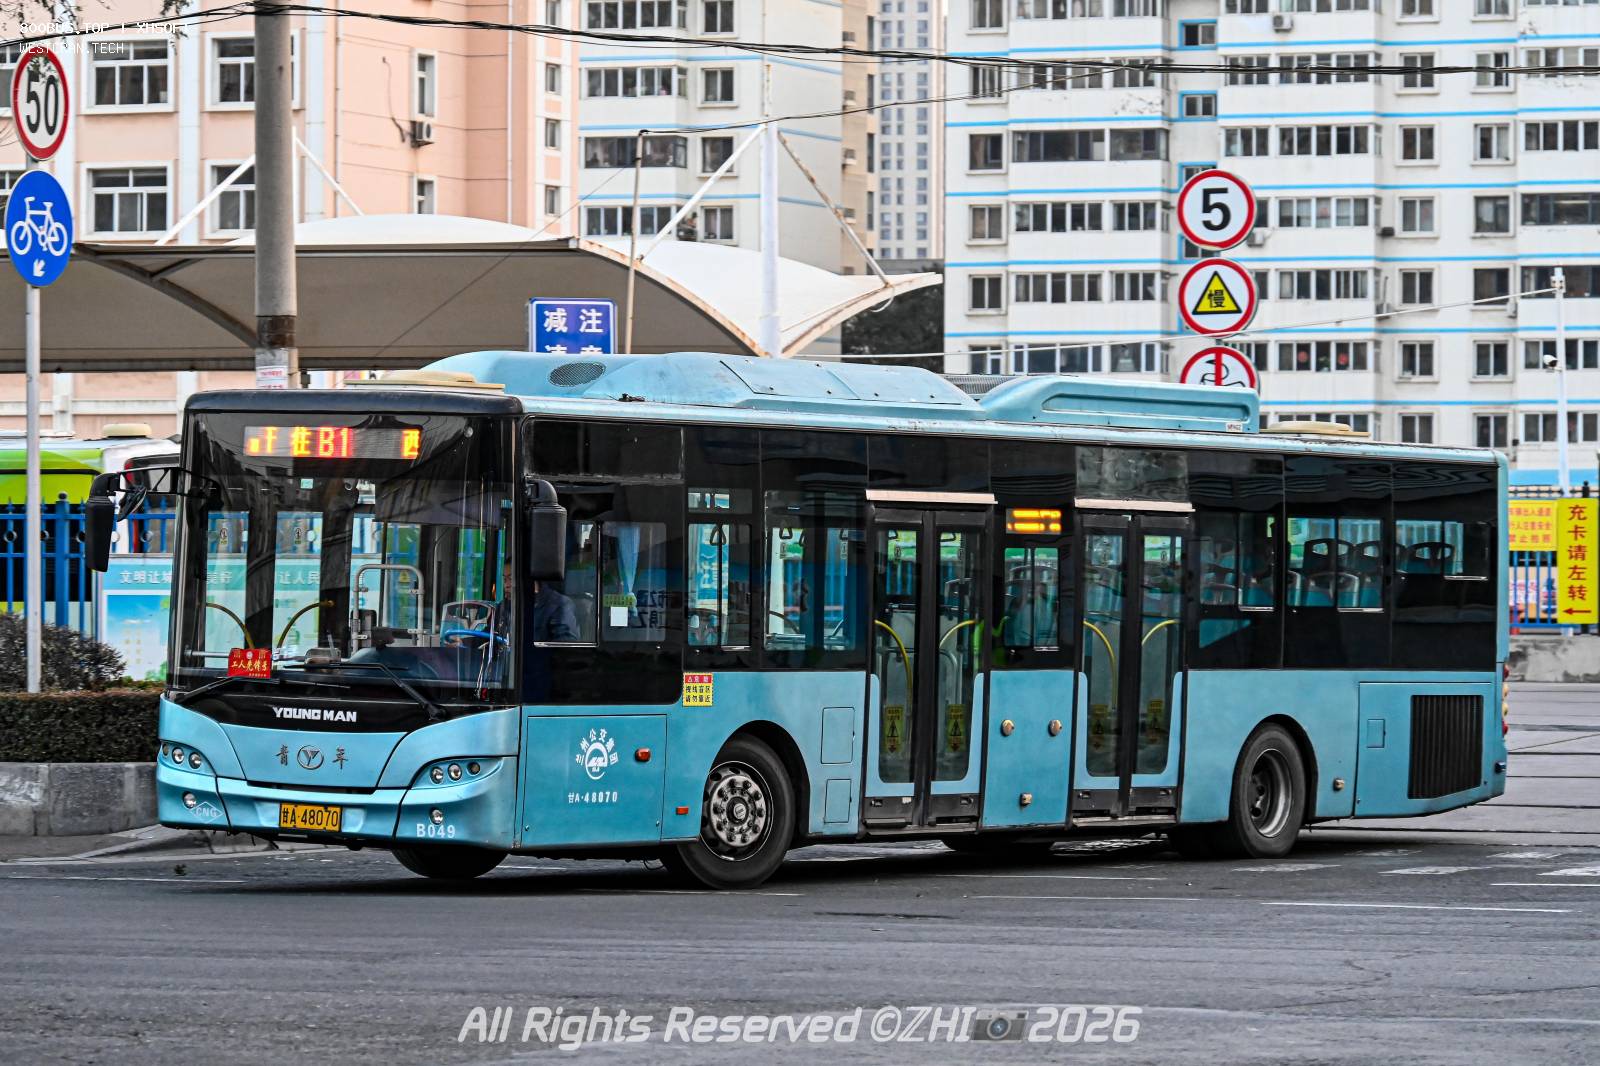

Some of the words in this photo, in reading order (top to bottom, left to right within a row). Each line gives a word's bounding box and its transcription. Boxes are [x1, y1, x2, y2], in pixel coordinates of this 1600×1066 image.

[26, 69, 59, 136] 50
[1201, 187, 1232, 232] 5
[1207, 289, 1226, 308] 慢
[318, 426, 350, 458] B1
[1567, 504, 1588, 601] 充卡请左转
[272, 706, 321, 720] YOUNG
[323, 709, 357, 723] MAN
[195, 806, 218, 818] CNG
[282, 807, 339, 827] 甘A·48070
[416, 823, 456, 838] B049
